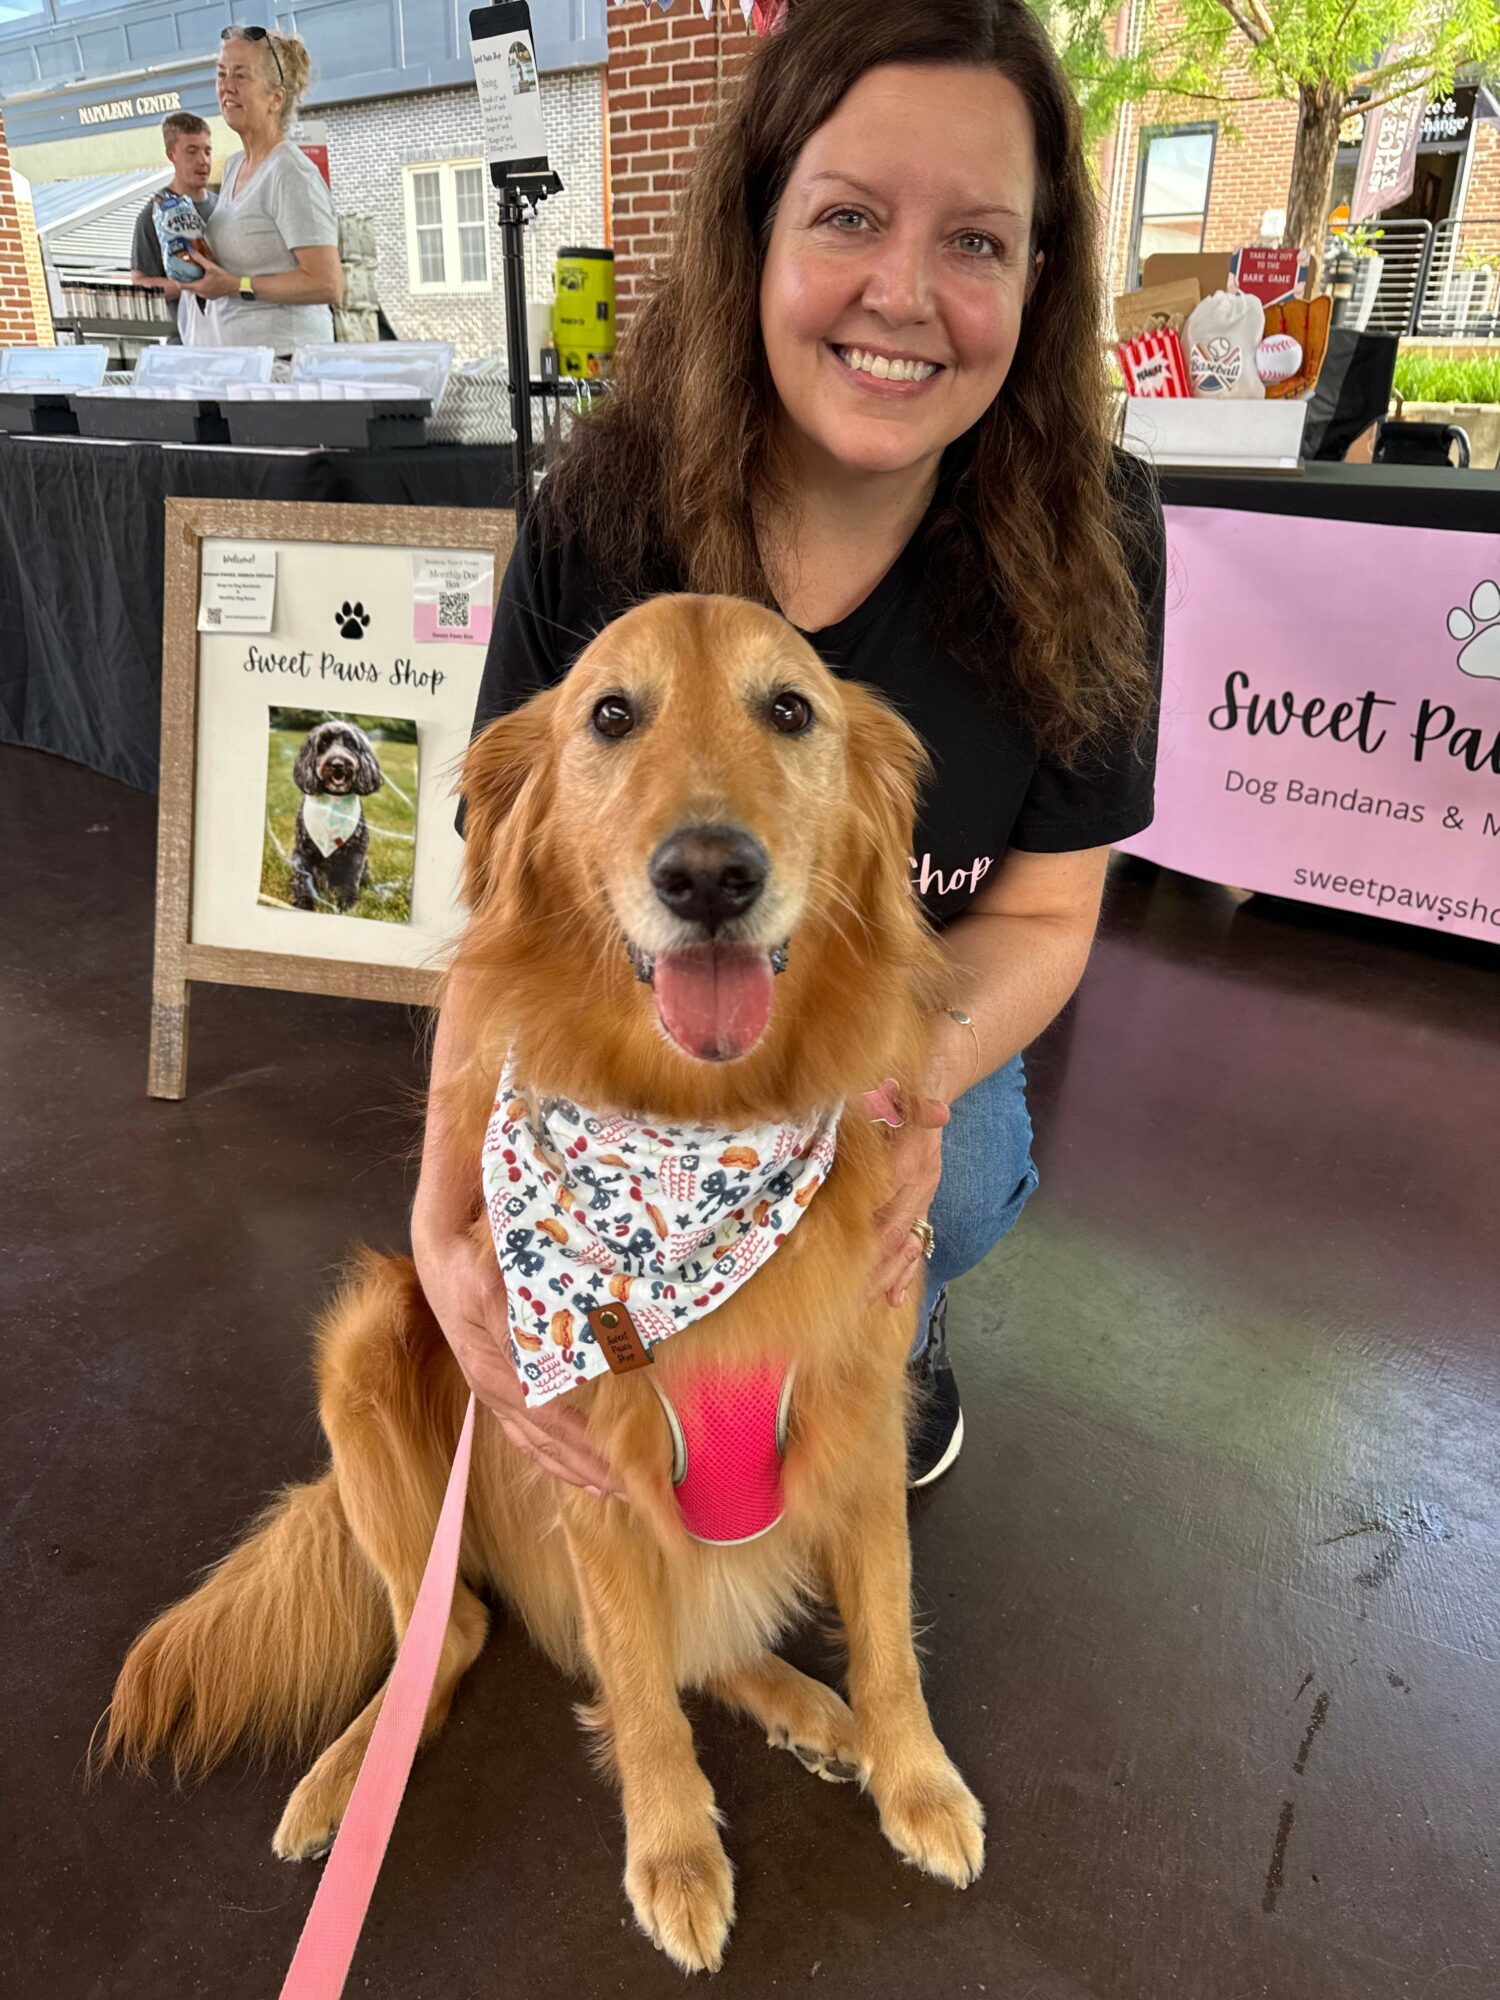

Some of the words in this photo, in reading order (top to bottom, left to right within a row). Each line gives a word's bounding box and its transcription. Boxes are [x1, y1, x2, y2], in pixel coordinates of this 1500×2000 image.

[78, 99, 134, 125] NAPOLEON
[136, 92, 181, 115] CENTER
[1442, 97, 1457, 115] &
[1368, 116, 1397, 188] SPICE
[1257, 261, 1265, 269] TO
[1267, 261, 1280, 269] THE
[1267, 252, 1278, 260] ME
[1243, 273, 1264, 282] BARK
[1268, 274, 1291, 283] GAME
[1192, 360, 1240, 377] Baseball
[243, 646, 313, 677] Sweet
[320, 651, 381, 683] Paws
[389, 658, 446, 695] Shop
[1209, 670, 1396, 753] Sweet
[1410, 698, 1500, 775] Pa
[1225, 769, 1278, 804] Dog
[1286, 779, 1425, 823] Bandanas
[1442, 805, 1464, 831] &
[909, 853, 994, 895] hop
[606, 1331, 629, 1345] Sweet
